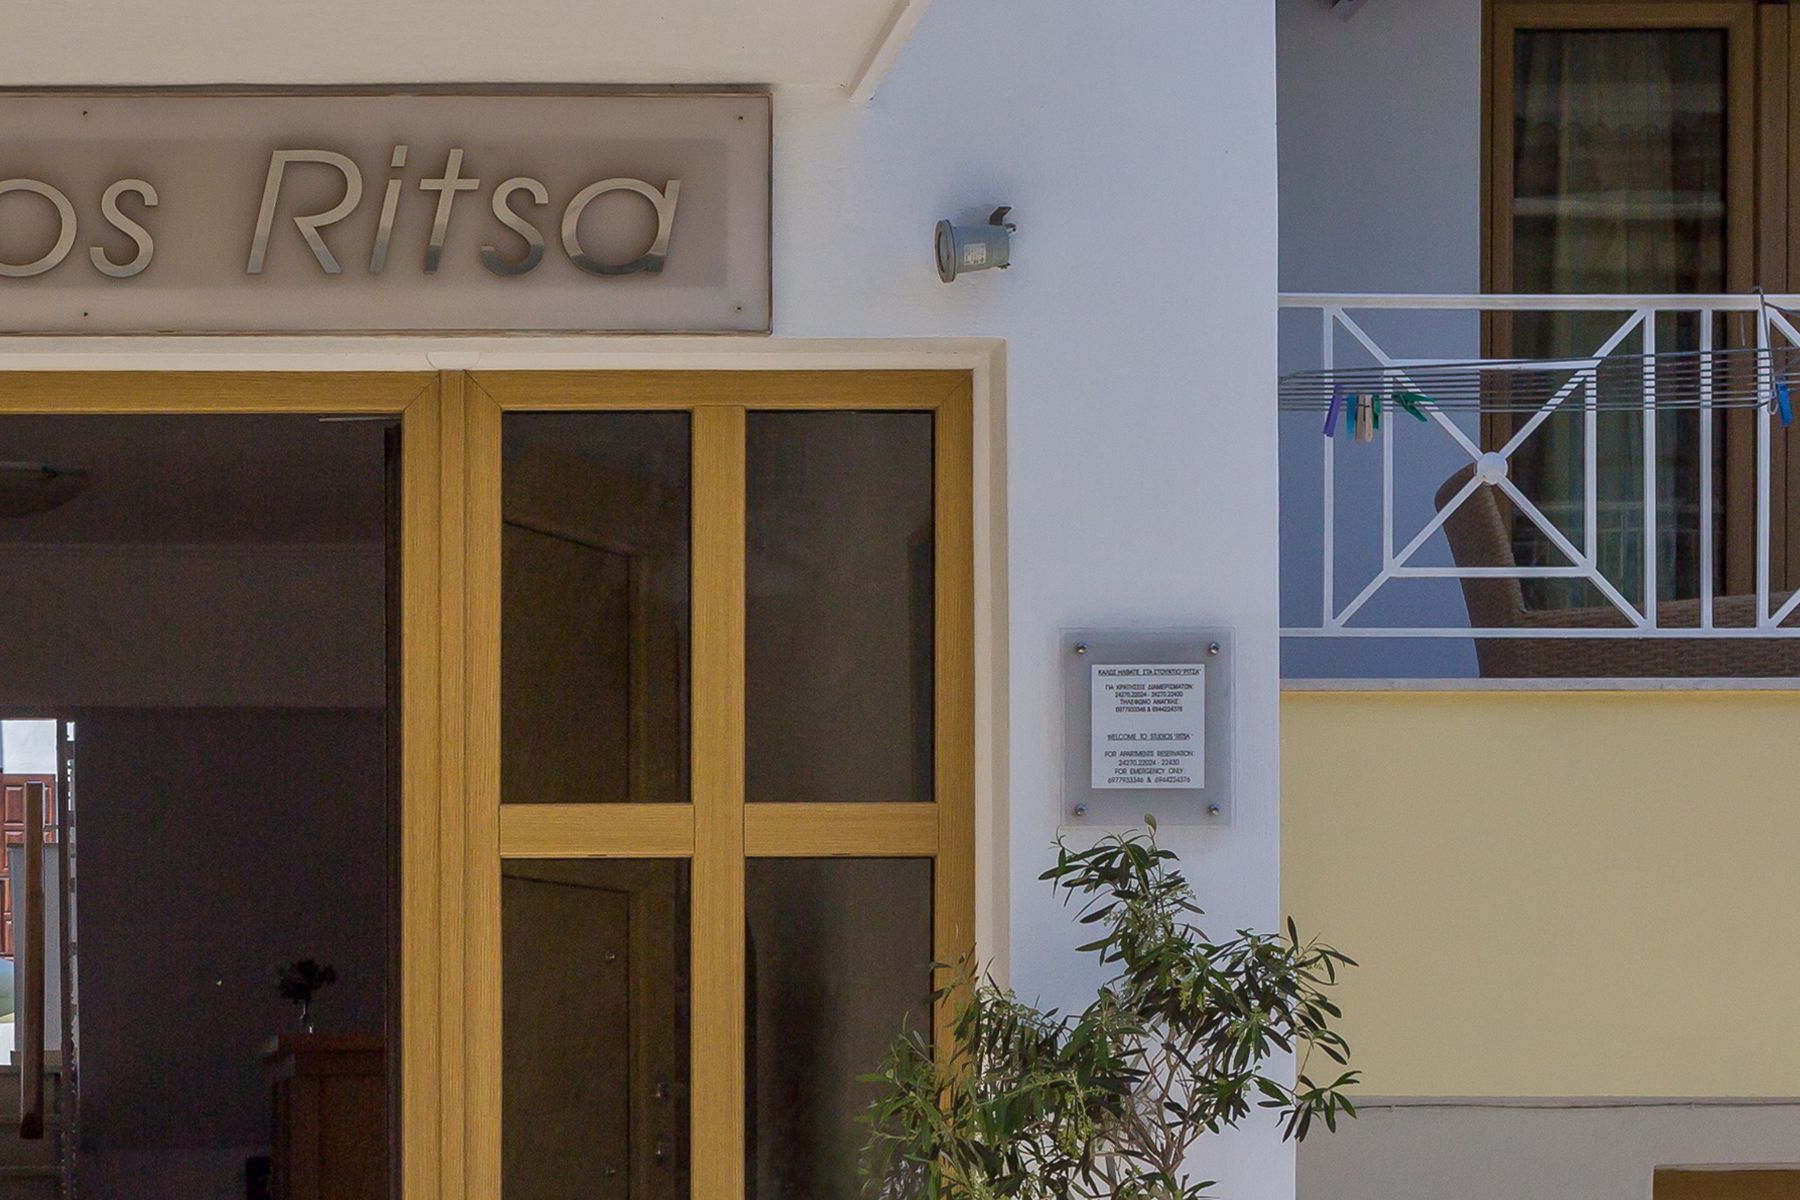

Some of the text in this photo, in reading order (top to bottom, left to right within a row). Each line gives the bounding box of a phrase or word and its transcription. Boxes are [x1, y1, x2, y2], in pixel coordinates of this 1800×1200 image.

[246, 146, 682, 278] Ritsa
[1107, 733, 1136, 741] WELCOME
[1140, 733, 1147, 741] TO
